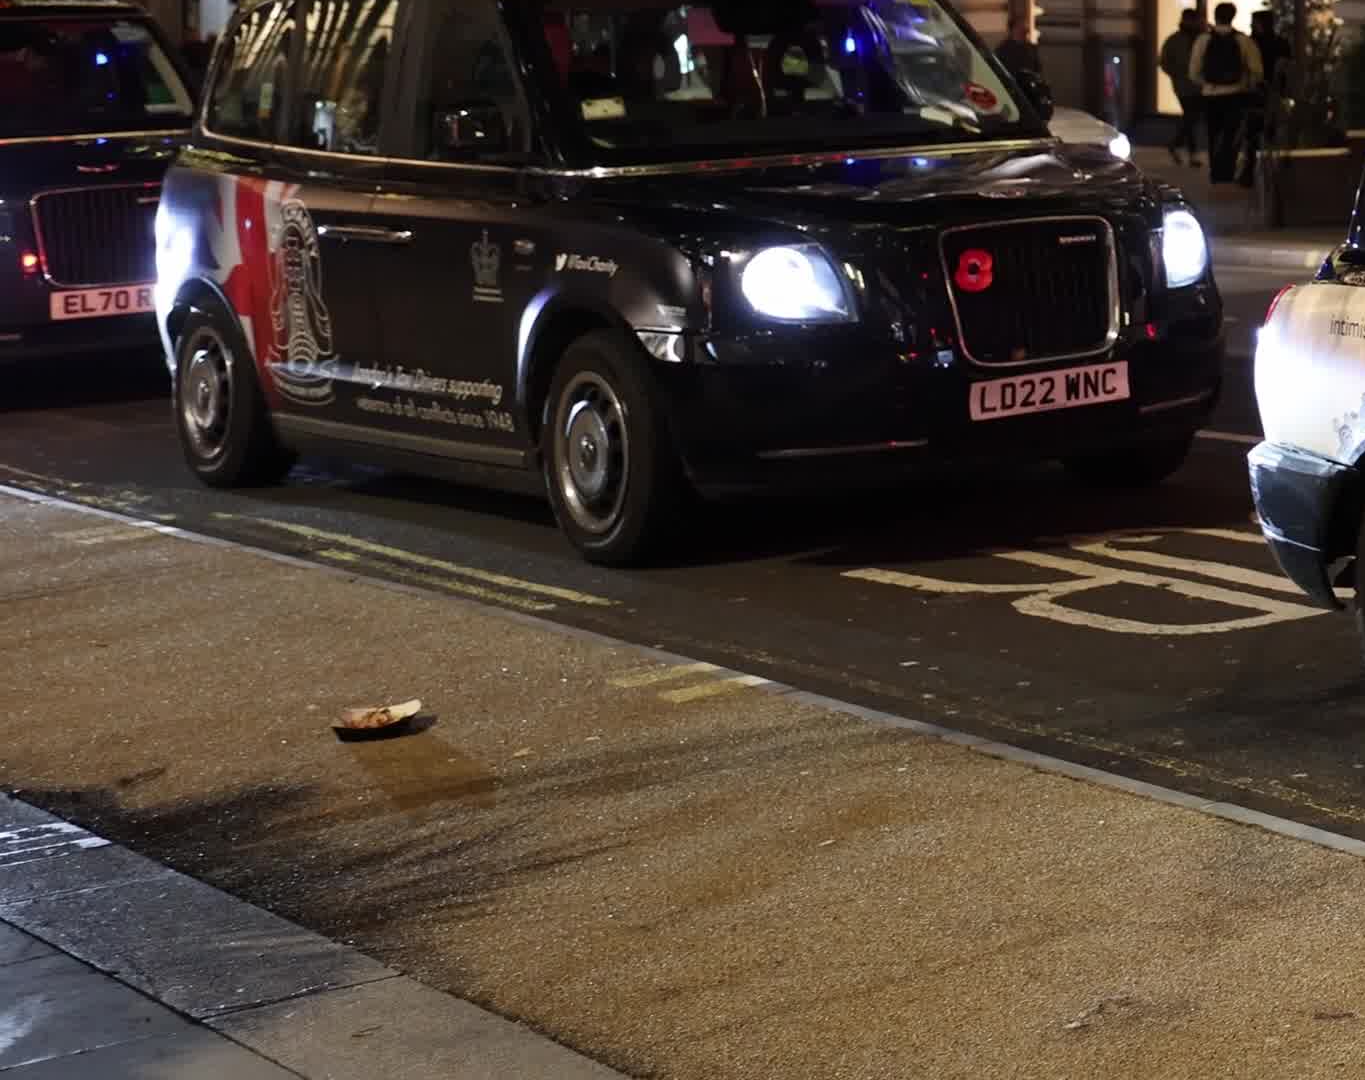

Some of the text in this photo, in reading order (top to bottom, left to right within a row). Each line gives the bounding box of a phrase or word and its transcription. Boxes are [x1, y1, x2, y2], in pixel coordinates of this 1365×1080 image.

[63, 290, 131, 315] EL70
[980, 368, 1118, 413] LD22 WNC
